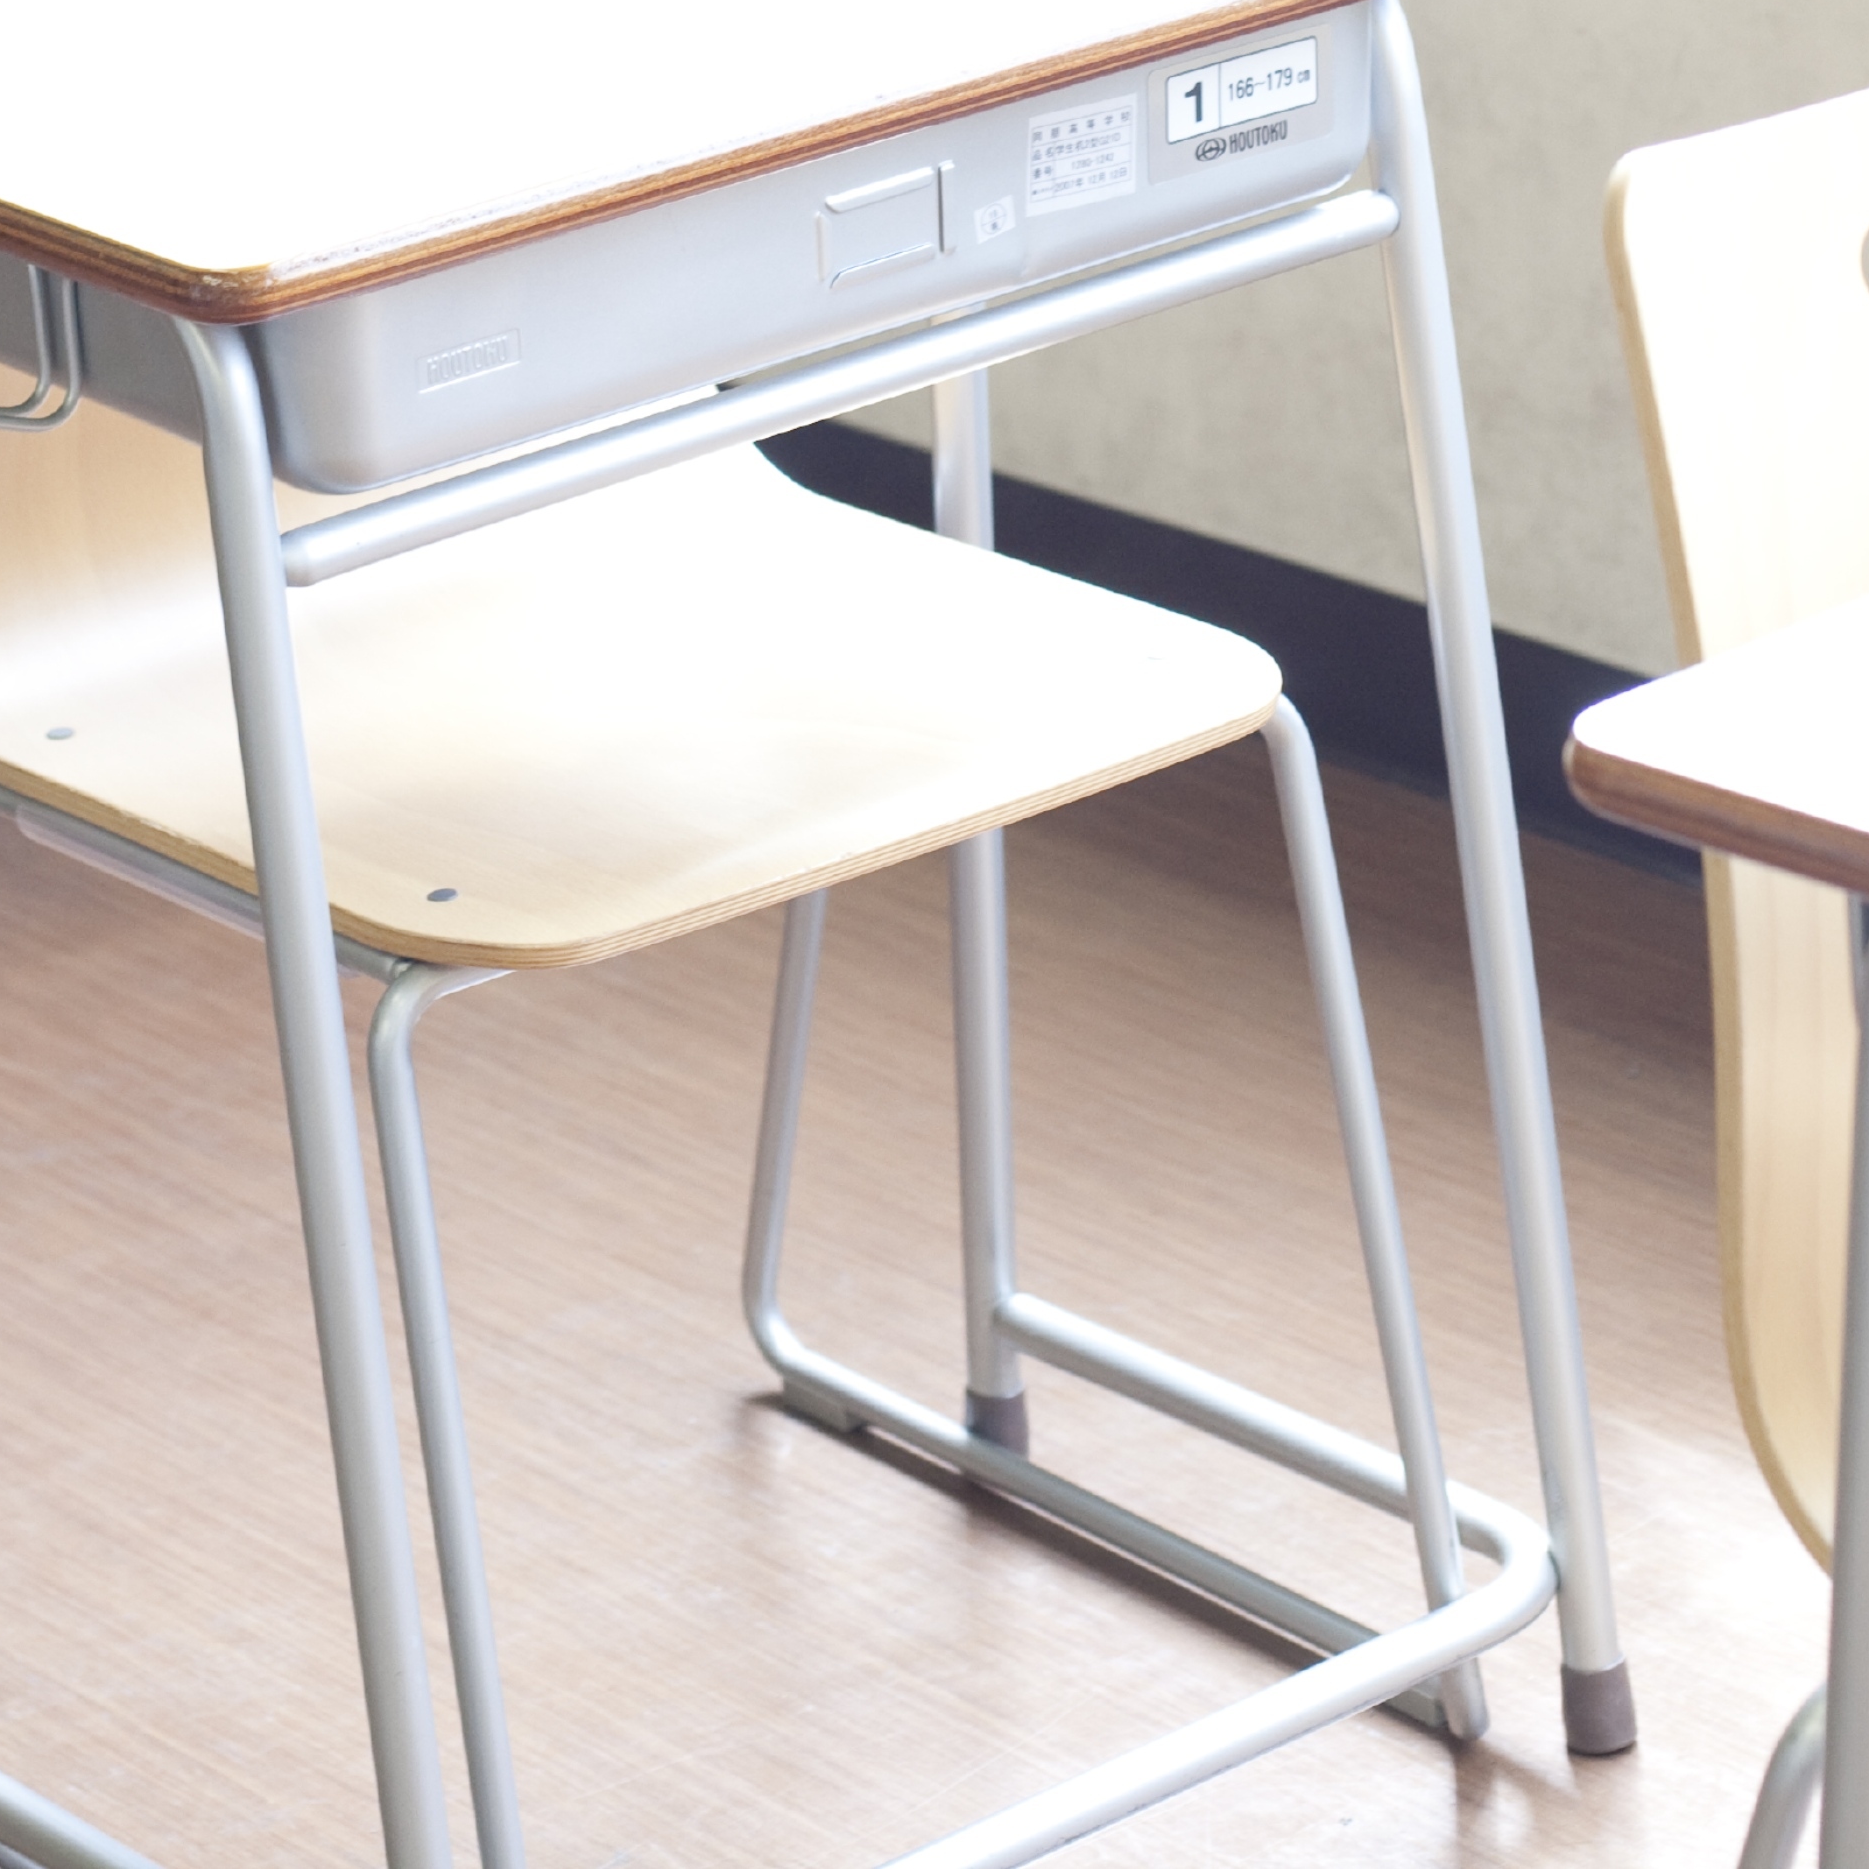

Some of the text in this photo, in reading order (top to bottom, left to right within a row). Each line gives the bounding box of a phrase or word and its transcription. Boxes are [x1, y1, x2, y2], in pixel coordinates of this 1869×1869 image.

[1184, 81, 1203, 123] 1
[1229, 120, 1288, 154] HOUTOKU
[427, 335, 508, 385] HOUTOKU
